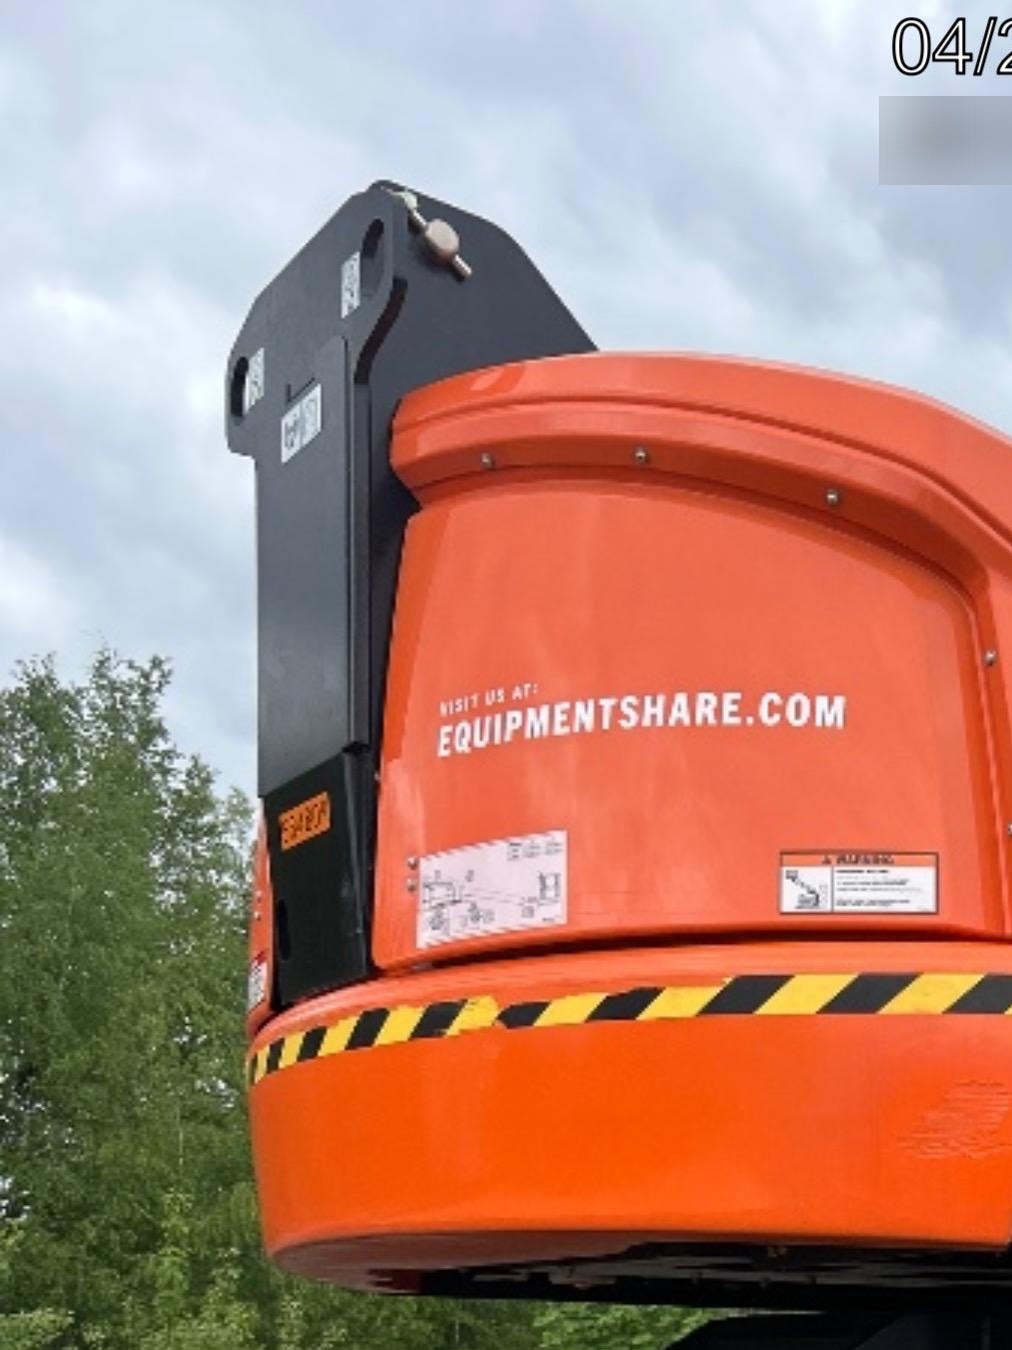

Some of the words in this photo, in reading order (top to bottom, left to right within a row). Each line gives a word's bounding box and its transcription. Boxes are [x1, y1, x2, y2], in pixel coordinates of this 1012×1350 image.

[437, 692, 847, 757] EQUIPMENTSHARE.COM
[439, 693, 479, 718] VISIT
[484, 688, 505, 706] US
[511, 683, 538, 700] AT:
